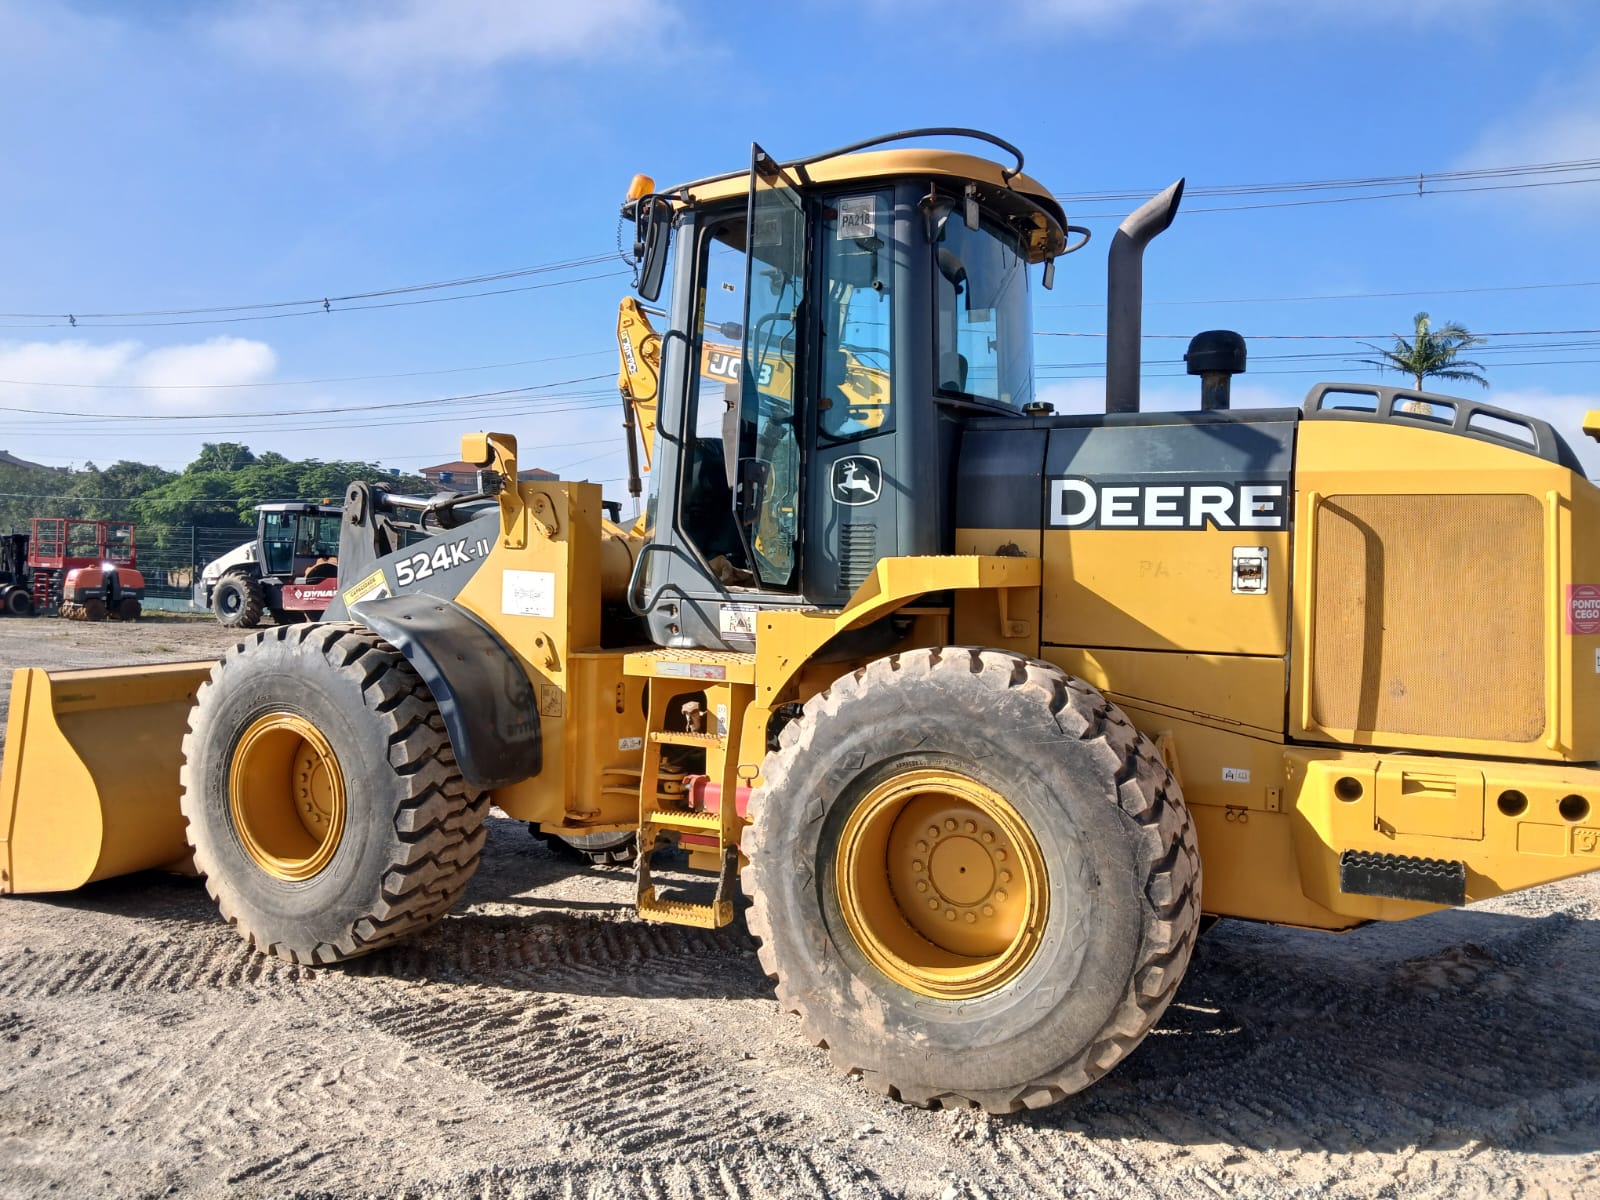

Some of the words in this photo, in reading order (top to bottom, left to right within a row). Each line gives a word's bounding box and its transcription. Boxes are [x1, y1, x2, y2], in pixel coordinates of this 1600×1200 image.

[842, 213, 870, 228] PA218
[1049, 479, 1283, 527] DEERE
[1572, 599, 1600, 609] PONTO
[1575, 609, 1600, 619] CEGO
